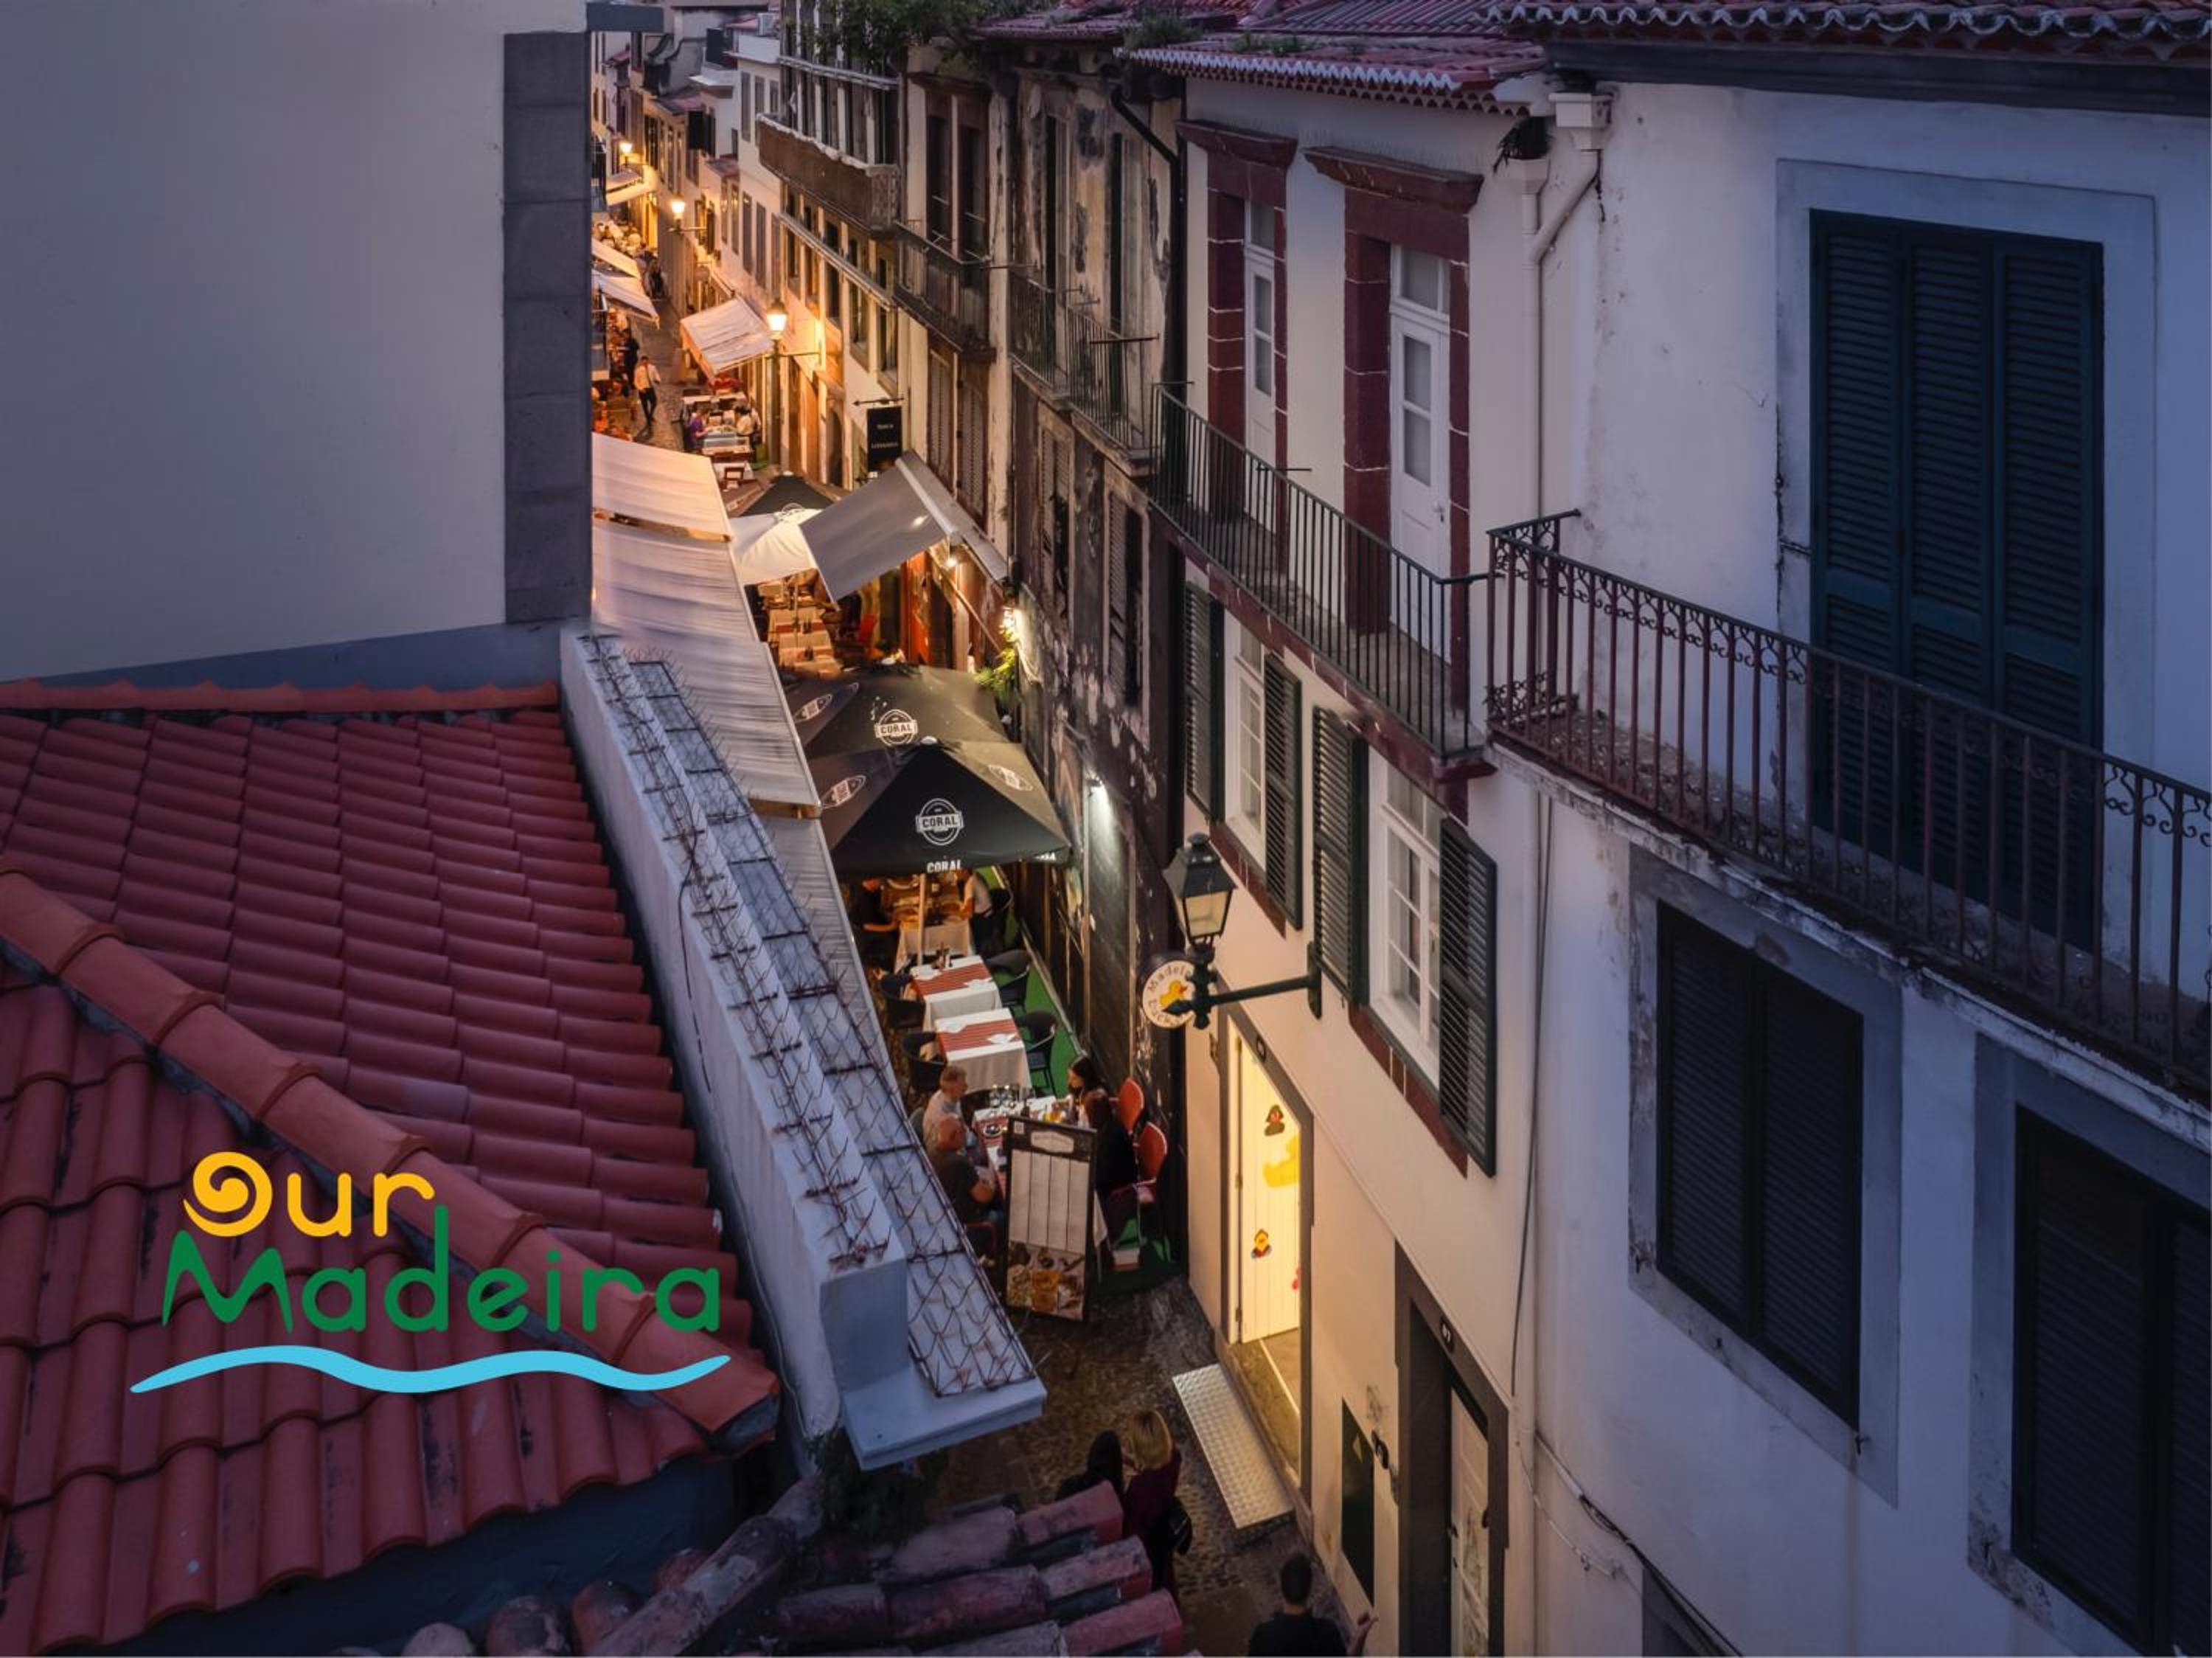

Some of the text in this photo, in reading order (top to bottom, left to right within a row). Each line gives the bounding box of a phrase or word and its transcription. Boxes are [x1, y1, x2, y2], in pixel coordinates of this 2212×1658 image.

[880, 724, 914, 735] CORAL
[922, 815, 958, 828] CORAL
[927, 859, 961, 873] CORAL
